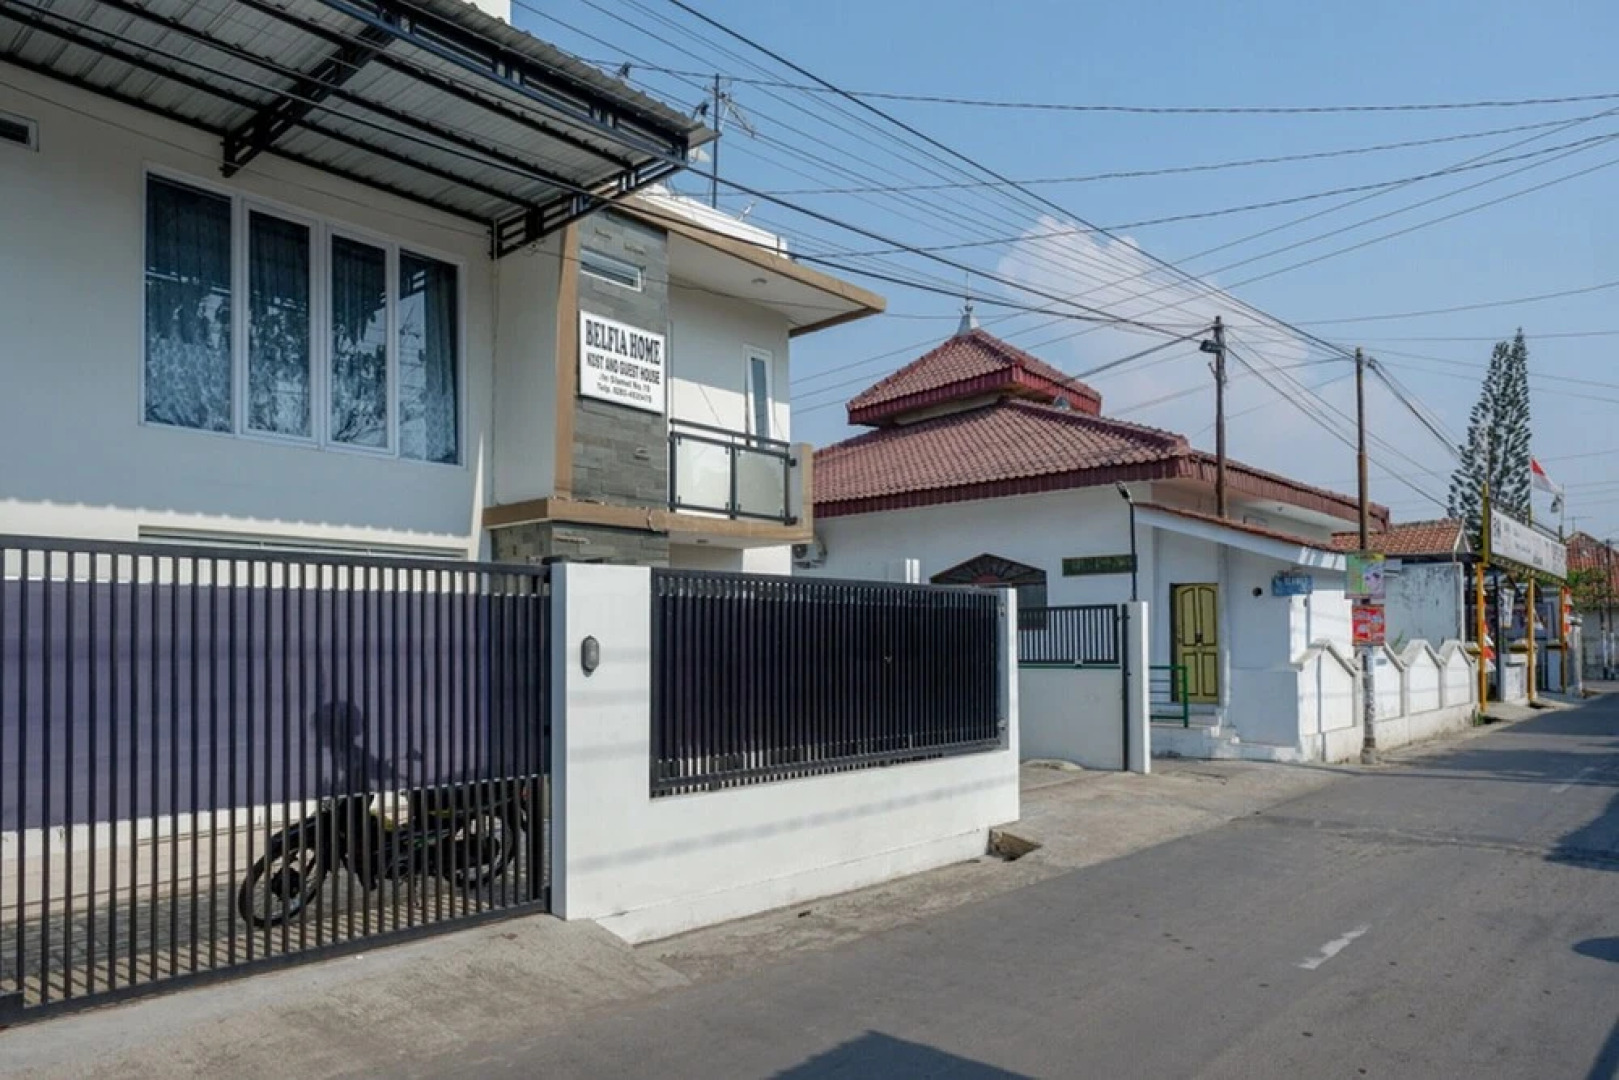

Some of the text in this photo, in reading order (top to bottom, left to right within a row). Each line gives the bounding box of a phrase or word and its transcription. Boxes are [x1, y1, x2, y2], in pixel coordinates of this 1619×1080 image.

[586, 319, 661, 365] BELFIA HOME
[587, 353, 660, 385] KOST AND GUEST HOUSE
